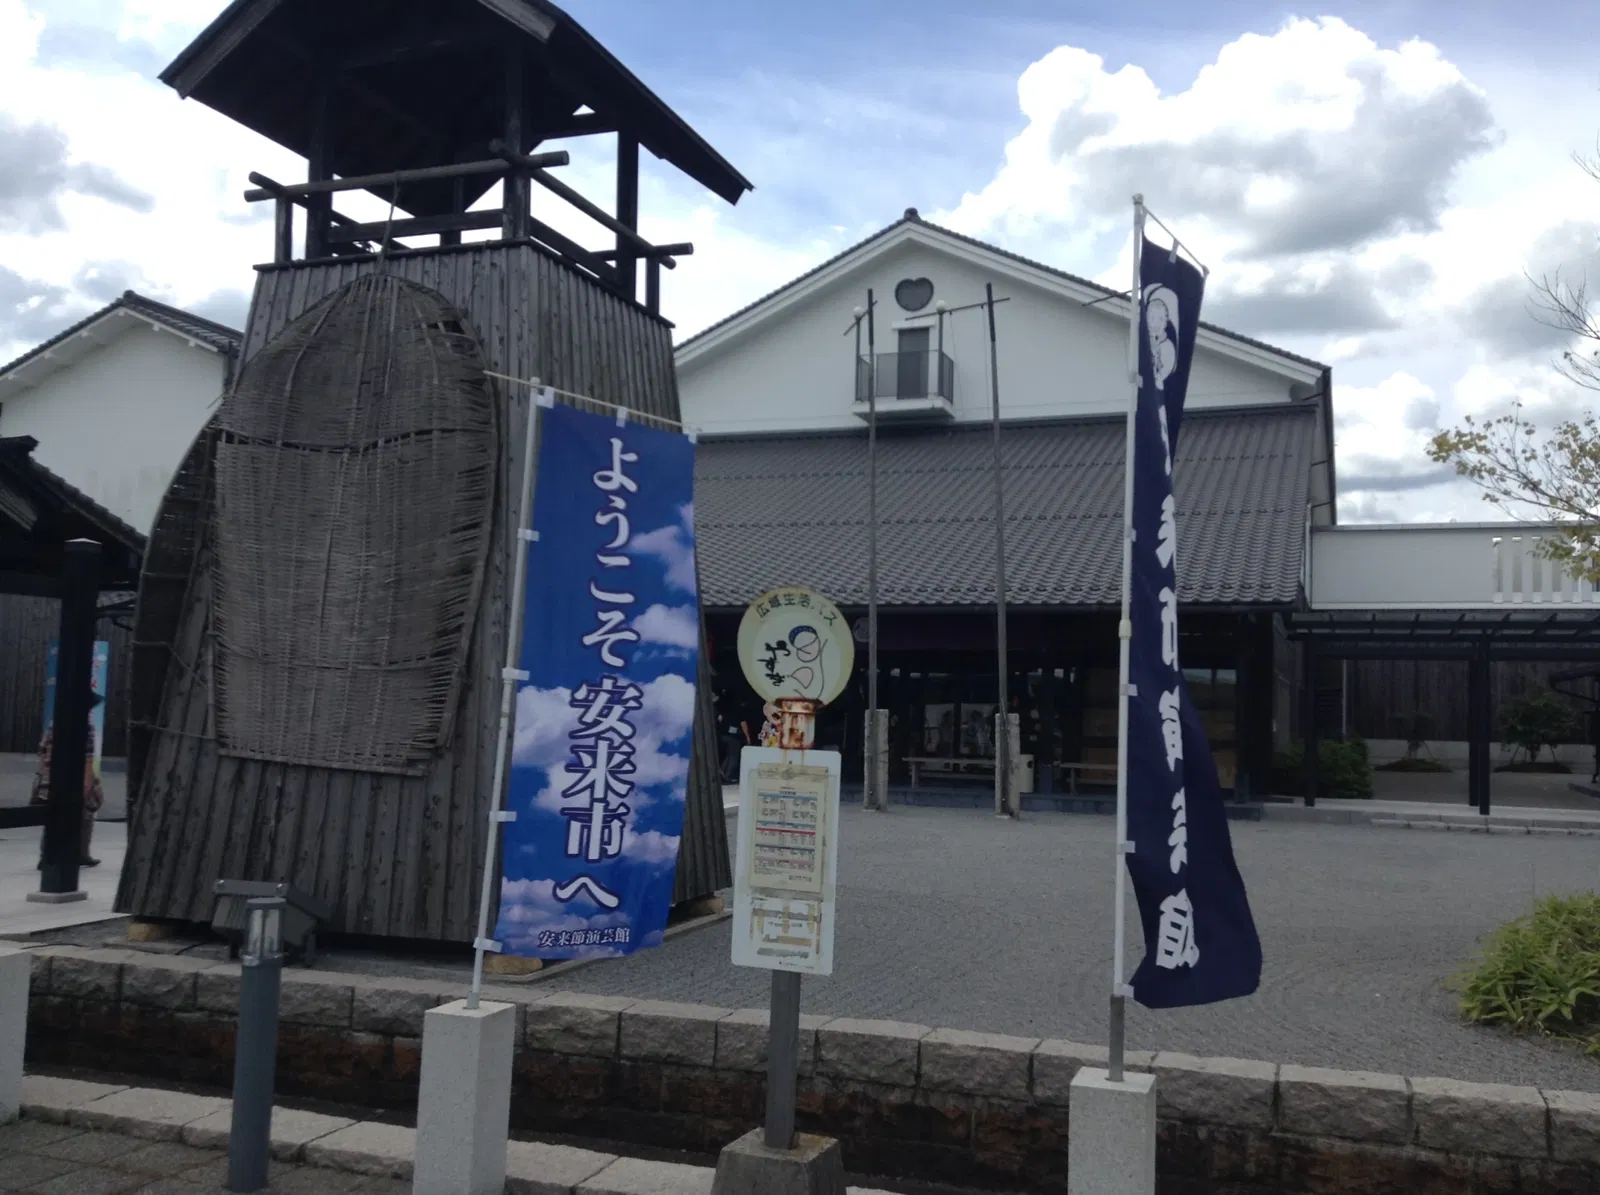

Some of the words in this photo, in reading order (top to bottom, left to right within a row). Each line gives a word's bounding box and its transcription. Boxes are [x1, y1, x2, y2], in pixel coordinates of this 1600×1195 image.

[556, 437, 642, 908] ようこそ安来市へ
[539, 926, 631, 947] 安来節演芸館
